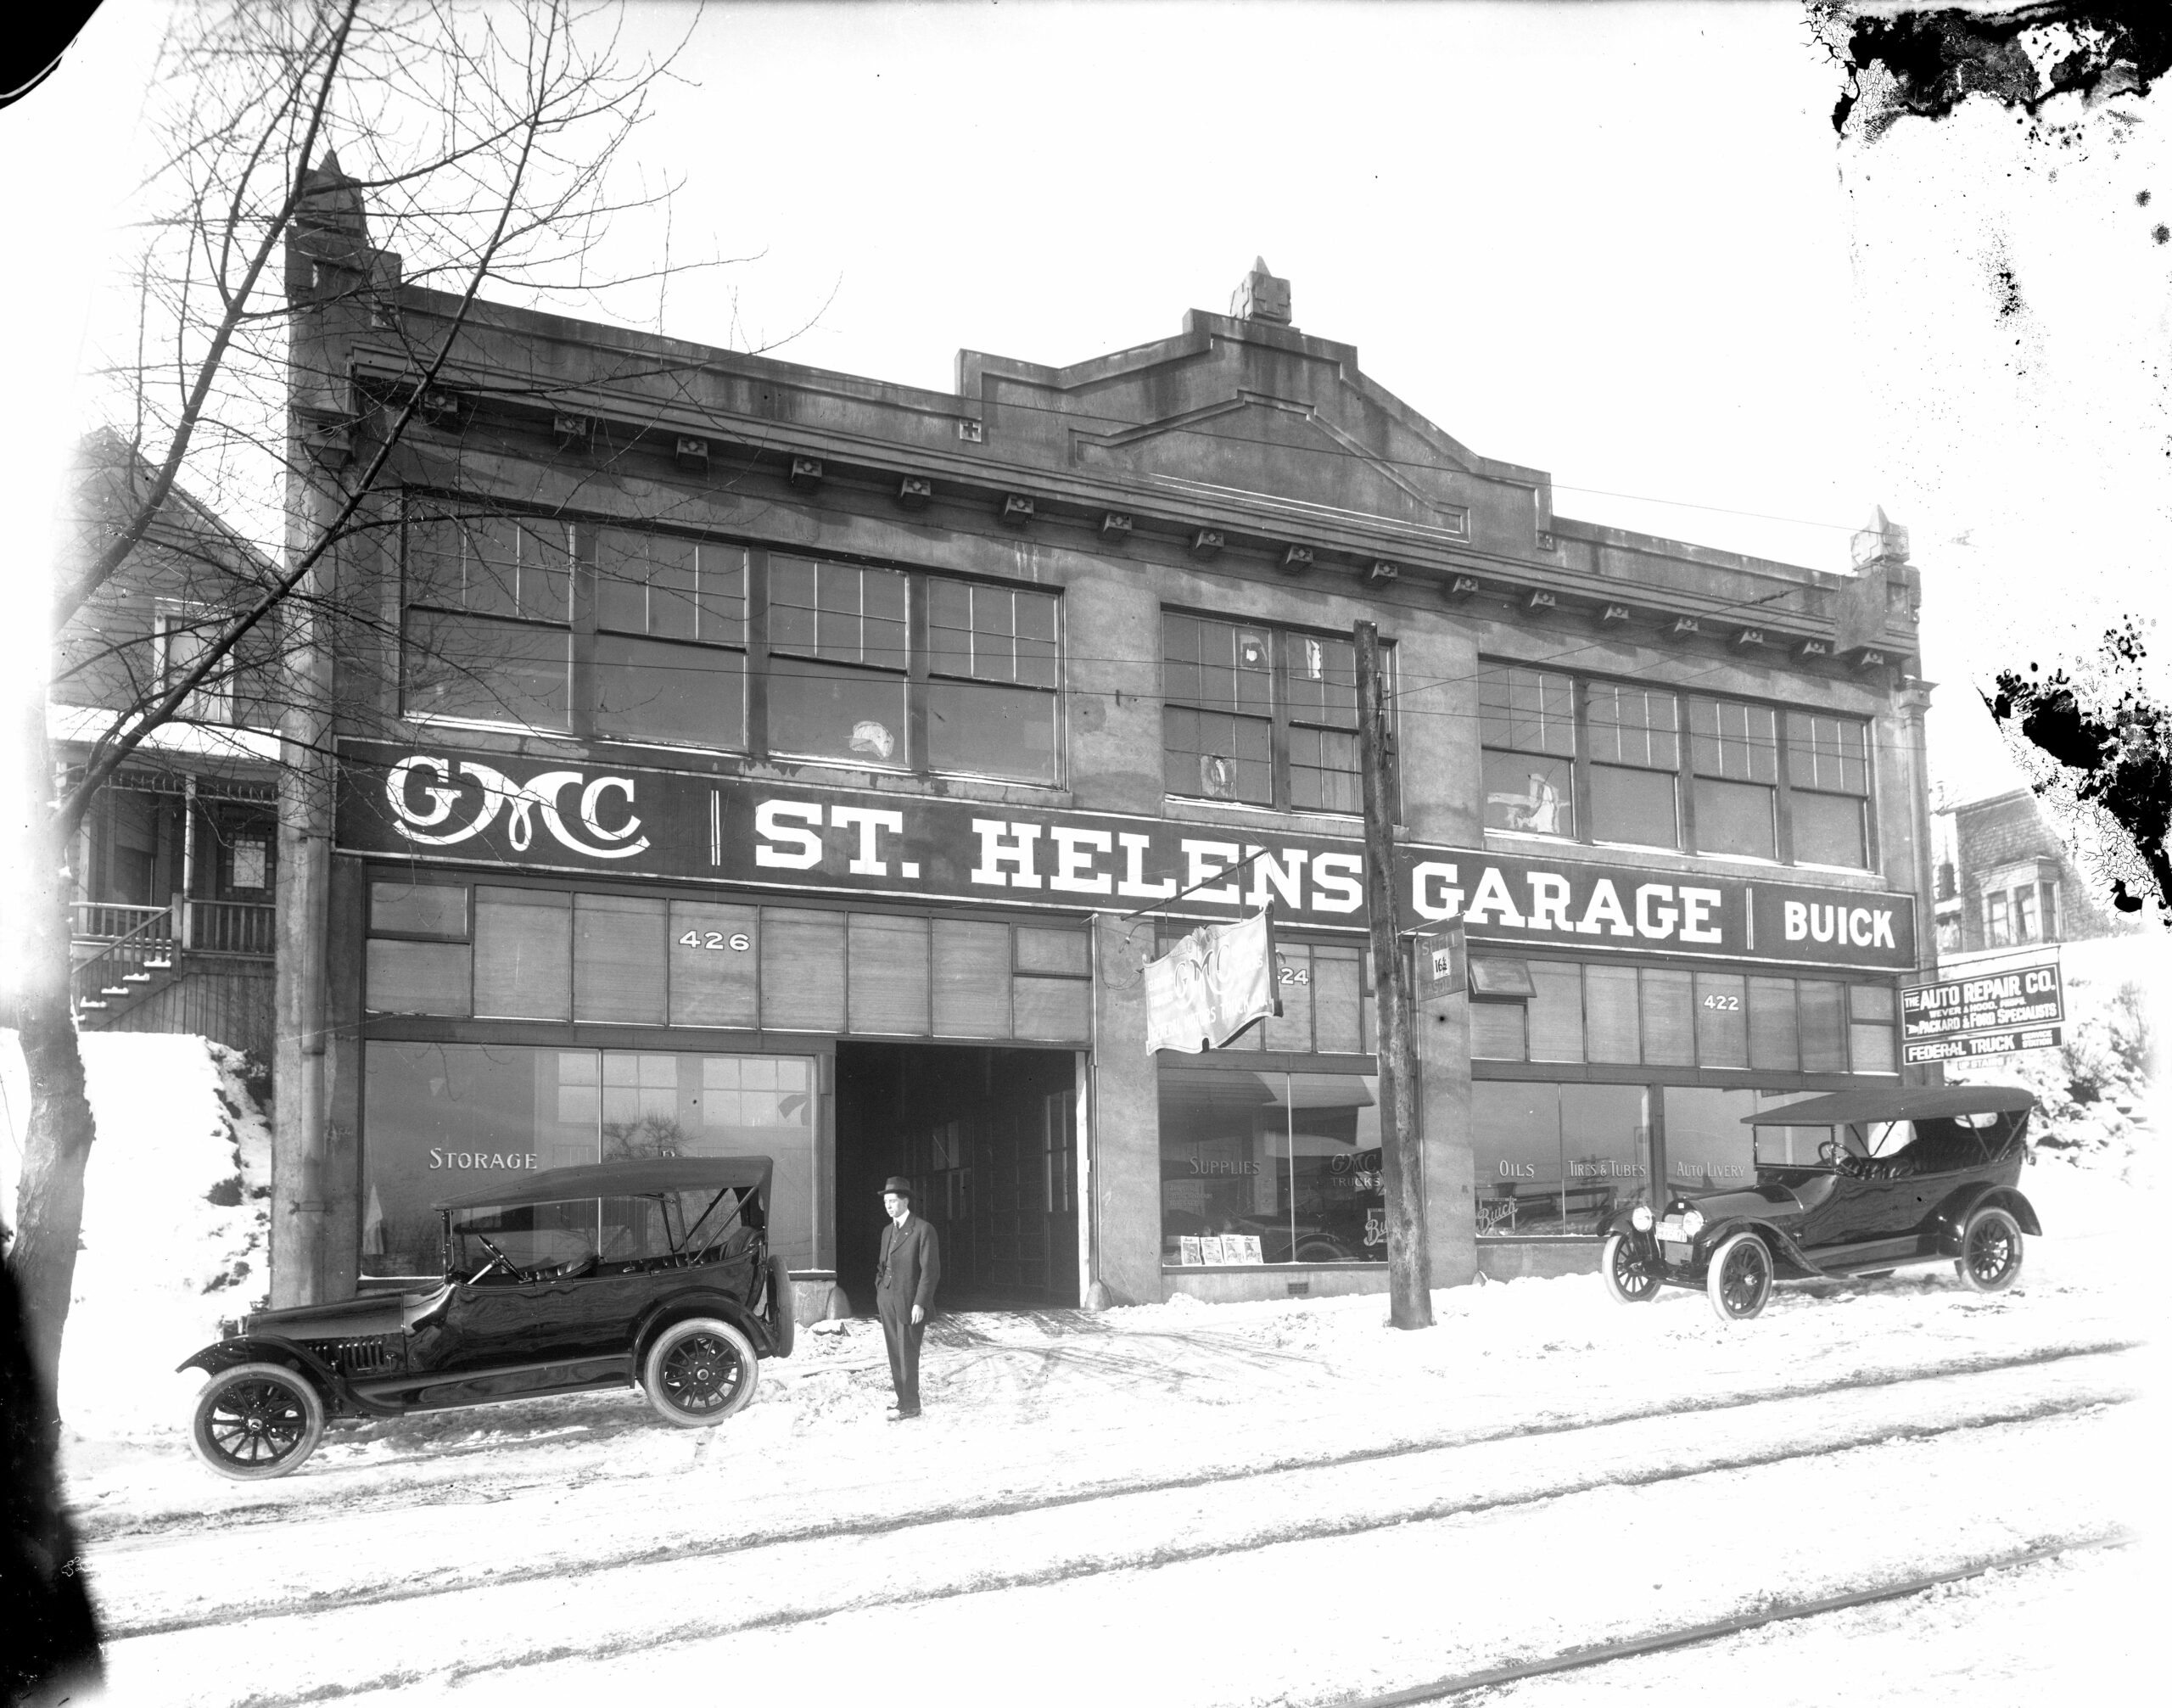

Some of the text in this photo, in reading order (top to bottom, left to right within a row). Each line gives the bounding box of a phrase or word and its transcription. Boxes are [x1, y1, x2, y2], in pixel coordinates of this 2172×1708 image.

[386, 755, 651, 859] GMC
[755, 799, 1722, 944] ST. HELENS GARAGE
[1784, 900, 1895, 949] BUICK
[679, 930, 750, 951] 426
[1422, 932, 1458, 956] SHELL
[1277, 967, 1309, 986] 24
[1904, 970, 2057, 1011] THE AUTO REPAIR CO.
[1705, 994, 1740, 1011] 422
[1928, 1006, 1961, 1018] WEVER
[1918, 1003, 2057, 1034] PACKARD & FORD SPECIALISTS
[1908, 1034, 2016, 1061] FEDERAL TRUCK
[429, 1147, 537, 1170] STORAGE
[1190, 1156, 1260, 1174] SUPPLIES
[1329, 1153, 1380, 1175] GMC
[1499, 1160, 1535, 1177] OILS
[1569, 1160, 1646, 1177] TIRES & TUBES
[1676, 1161, 1745, 1178] AUTO LIVERY
[1330, 1177, 1380, 1187] TRUCKS
[1476, 1195, 1519, 1233] Buick
